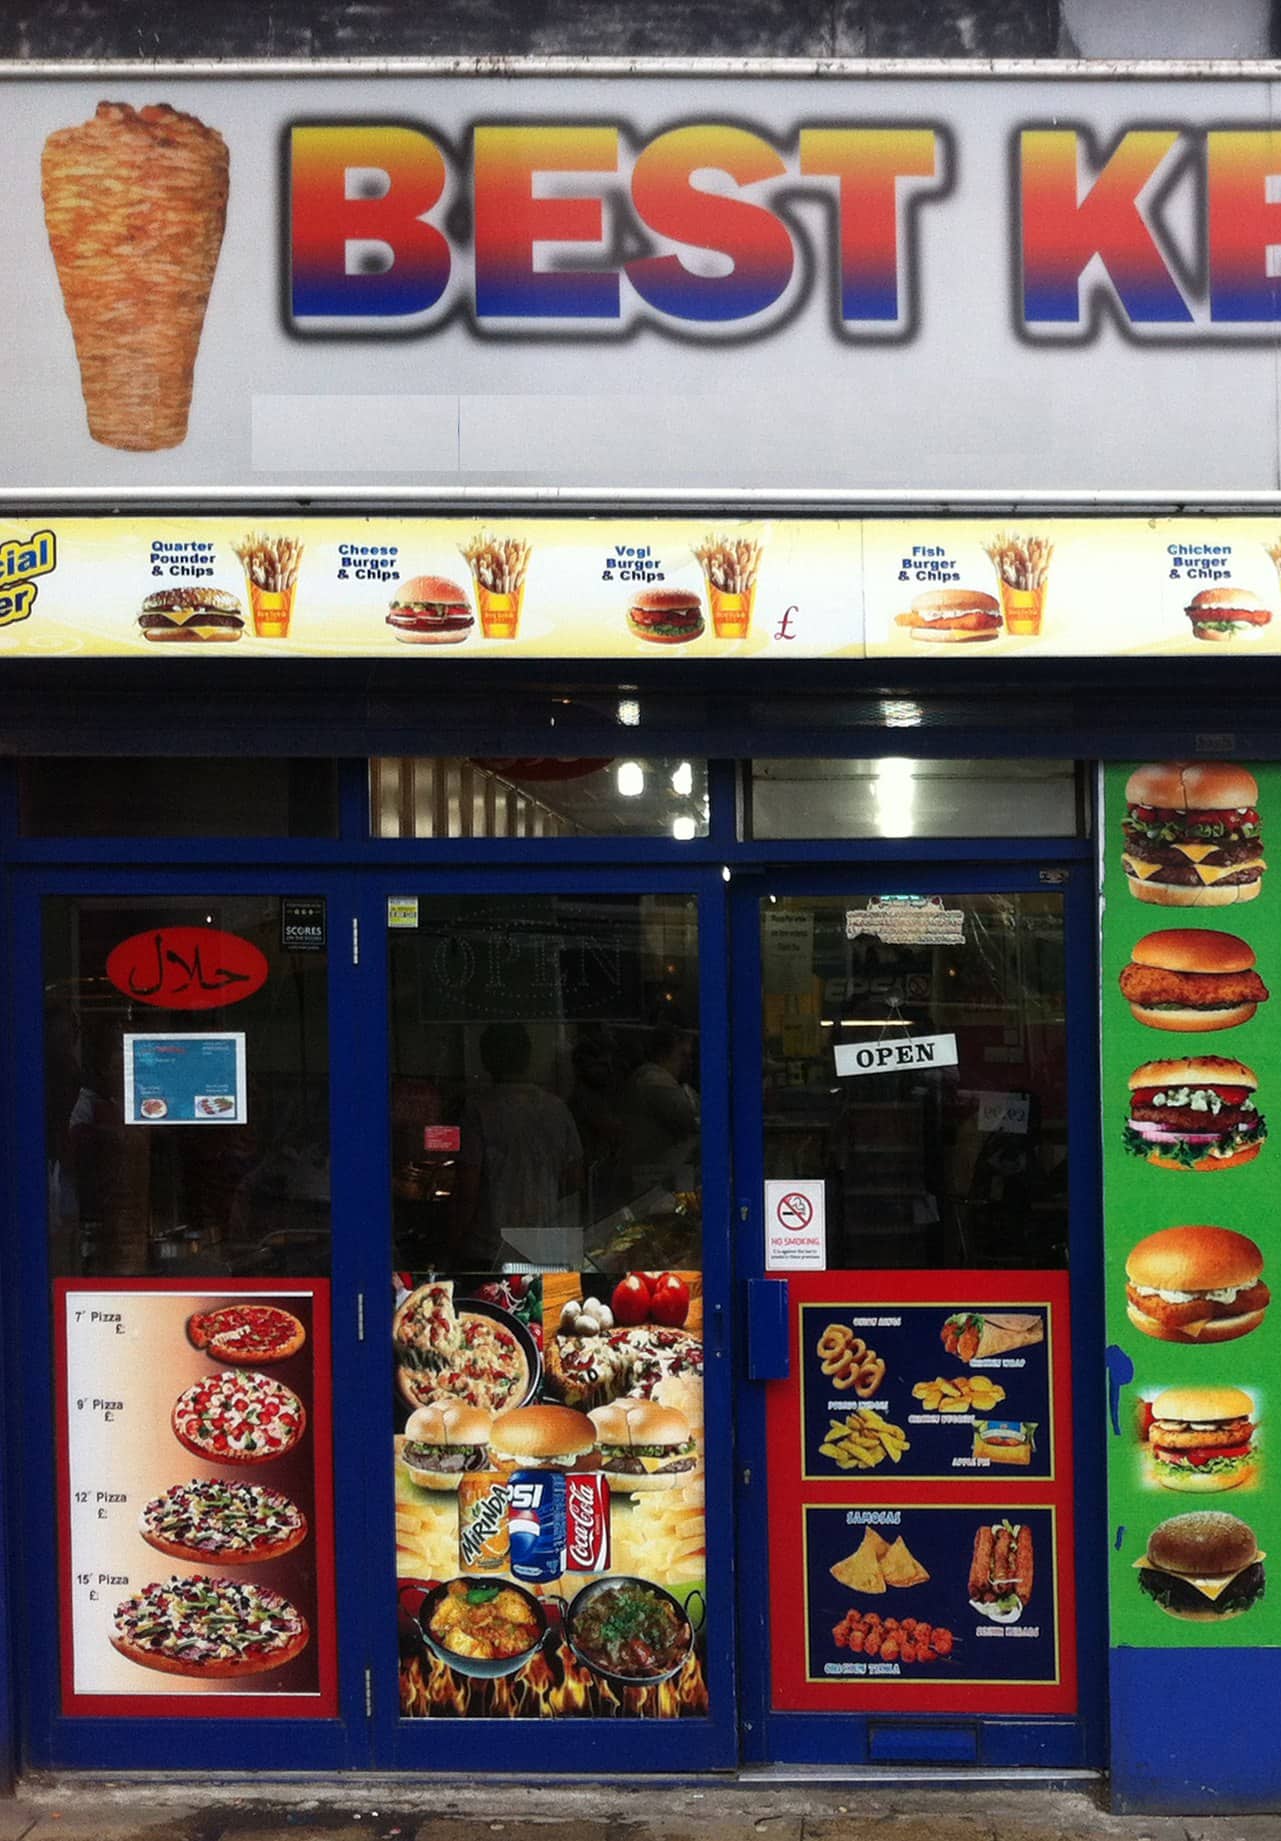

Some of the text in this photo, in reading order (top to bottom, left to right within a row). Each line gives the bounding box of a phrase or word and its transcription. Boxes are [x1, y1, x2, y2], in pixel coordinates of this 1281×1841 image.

[286, 120, 940, 326] BEST
[151, 541, 214, 553] Quarter
[338, 544, 399, 556] Cheese
[615, 545, 651, 559] Vegi
[912, 545, 946, 557] Fish
[1167, 544, 1232, 556] Chicken
[150, 554, 216, 564] Pounder
[341, 556, 397, 569] Burger
[606, 559, 661, 571] Burger
[902, 558, 957, 571] Burger
[1173, 556, 1227, 569] Burger
[152, 566, 214, 577] & Chips
[337, 569, 400, 582] & Chips
[602, 570, 665, 583] & Chips
[898, 570, 961, 583] & Chips
[1169, 568, 1232, 581] & Chips
[774, 605, 800, 641] £
[286, 926, 322, 936] SCORES
[128, 933, 250, 996] حلال
[856, 1043, 936, 1069] OPEN
[770, 1237, 820, 1246] NO SMOKING
[90, 1311, 122, 1323] Pizza
[92, 1398, 124, 1410] Pizza
[96, 1491, 127, 1503] Pizza
[98, 1574, 129, 1586] Pizza
